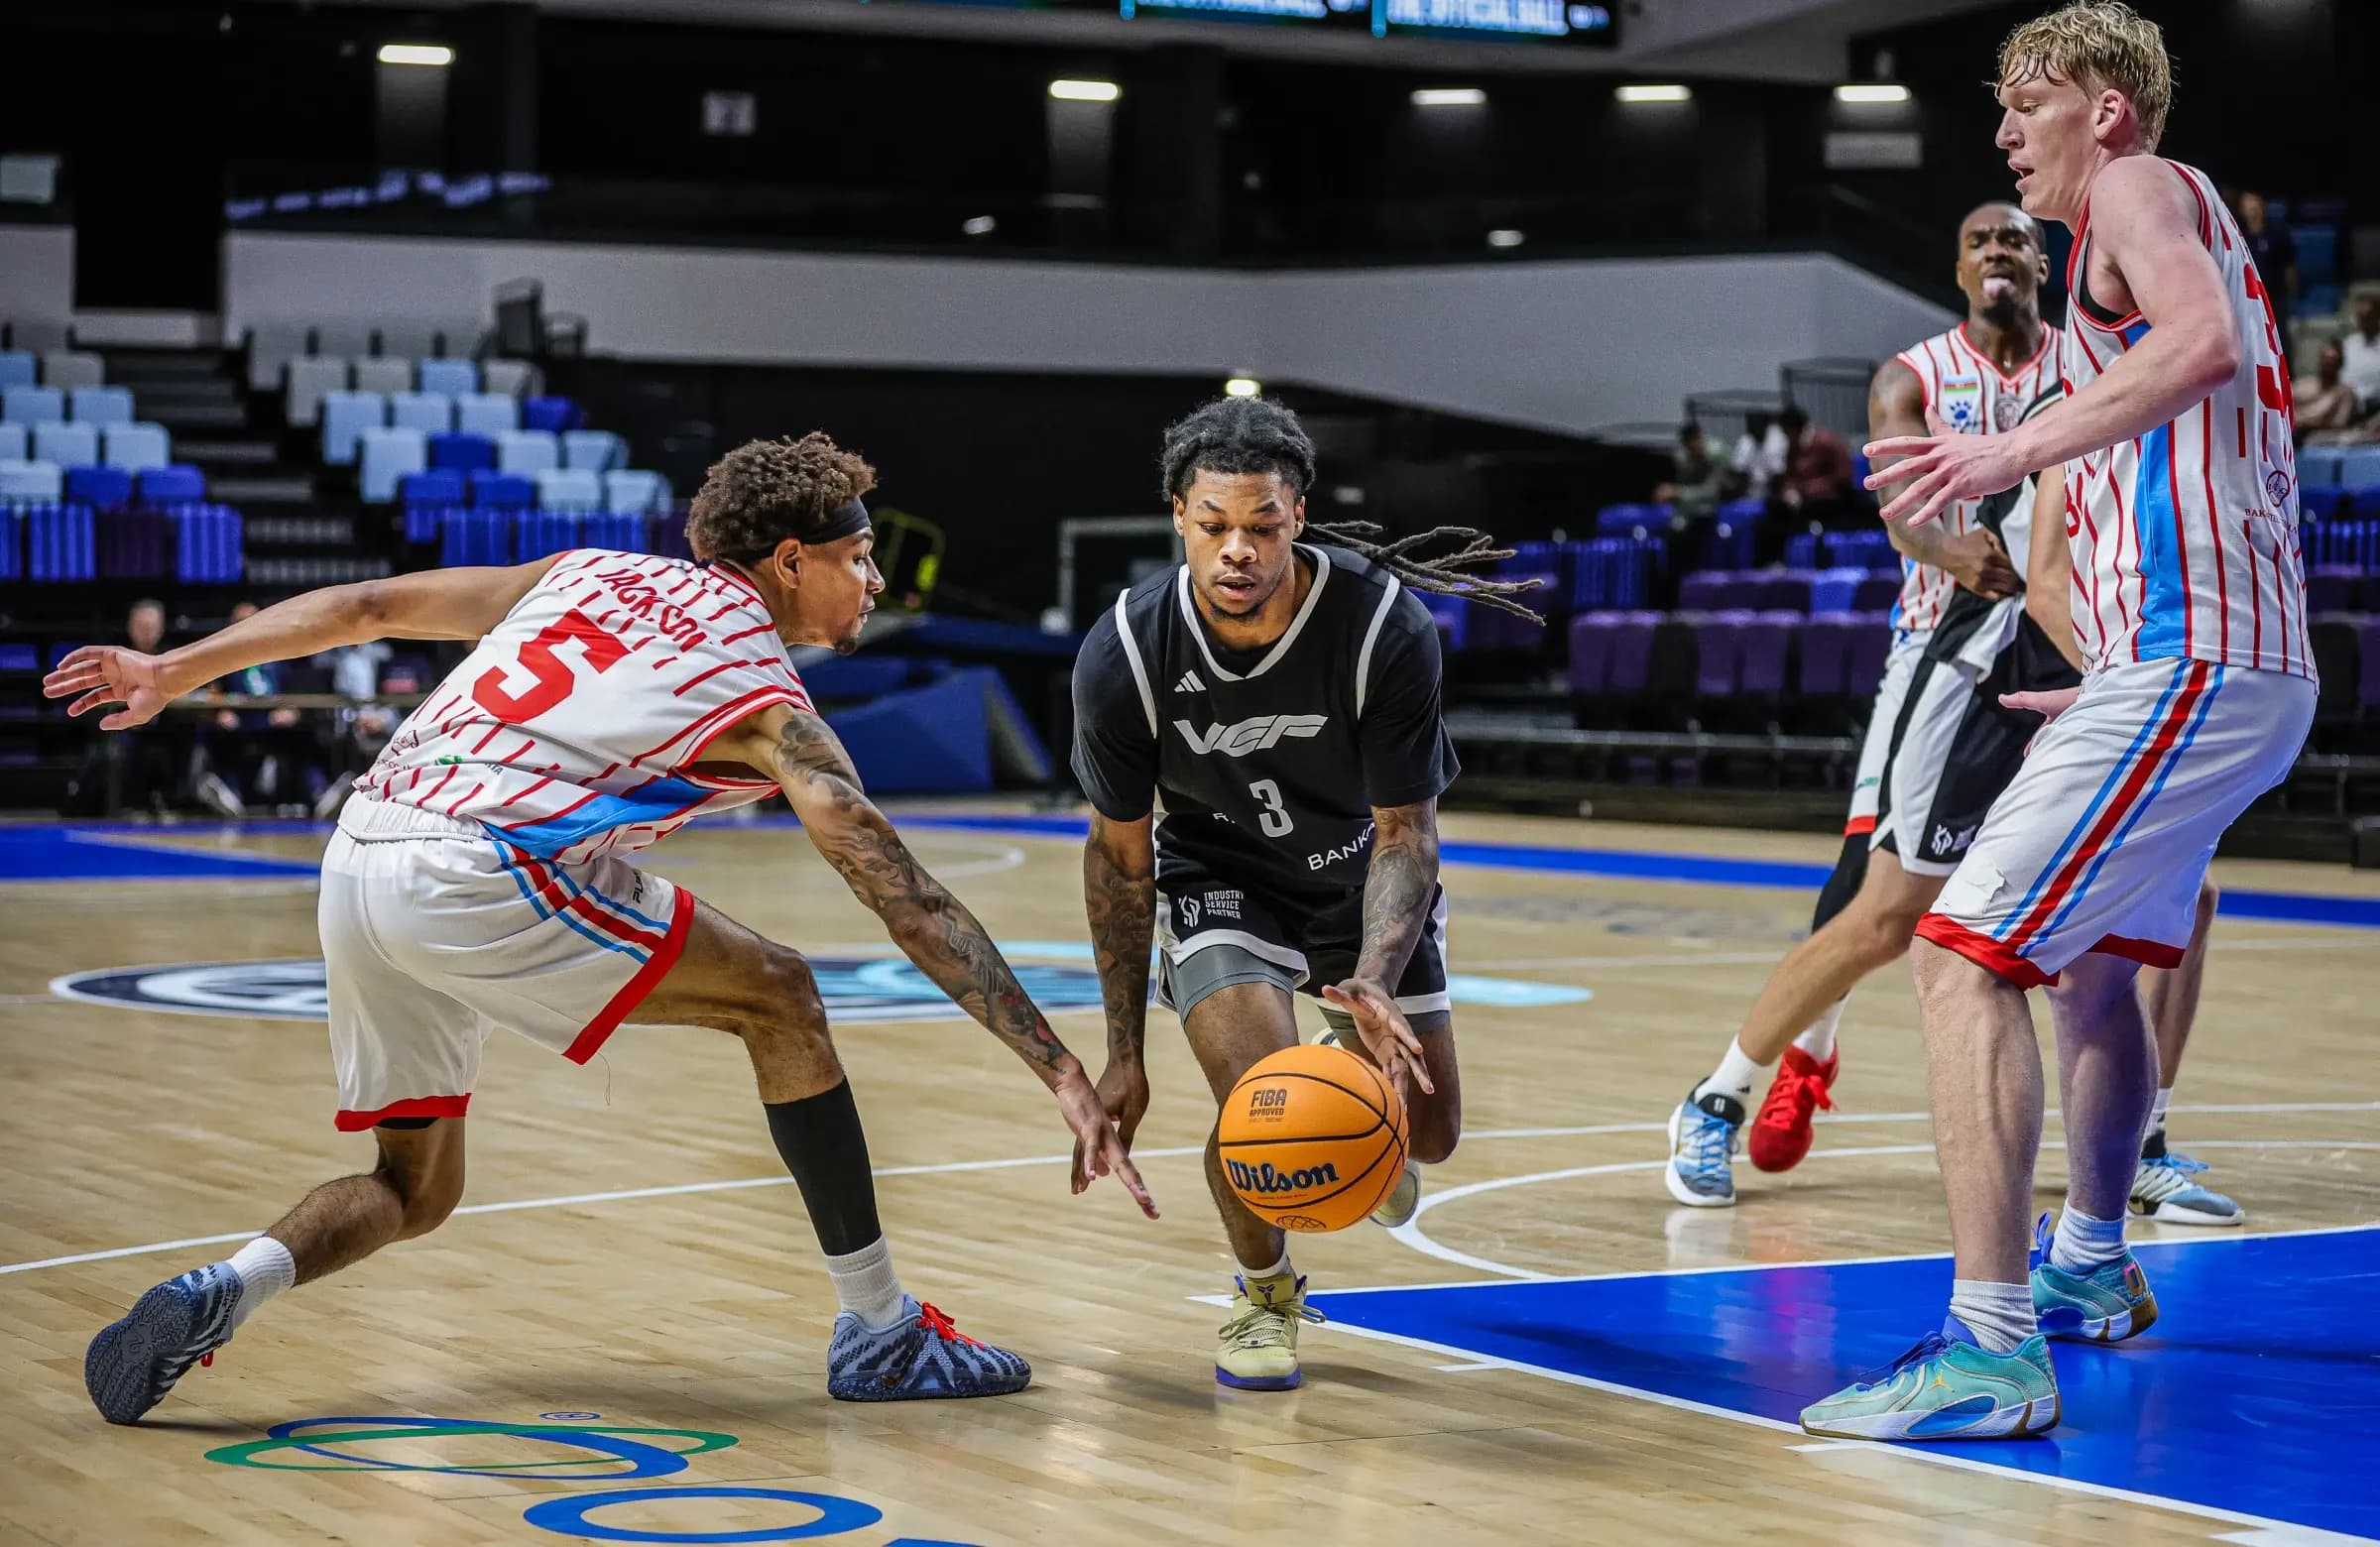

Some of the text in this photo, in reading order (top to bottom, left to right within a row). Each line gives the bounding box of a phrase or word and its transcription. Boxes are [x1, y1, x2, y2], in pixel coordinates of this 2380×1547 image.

[471, 608, 633, 725] 5
[1249, 778, 1294, 838] 3
[1204, 890, 1245, 901] INDUSTRY
[1205, 900, 1240, 910] SERVICE
[1207, 908, 1242, 920] PARTNER
[1250, 1088, 1287, 1108] FIBA
[1250, 1108, 1285, 1117] APPROVED
[1226, 1157, 1340, 1193] Wilson
